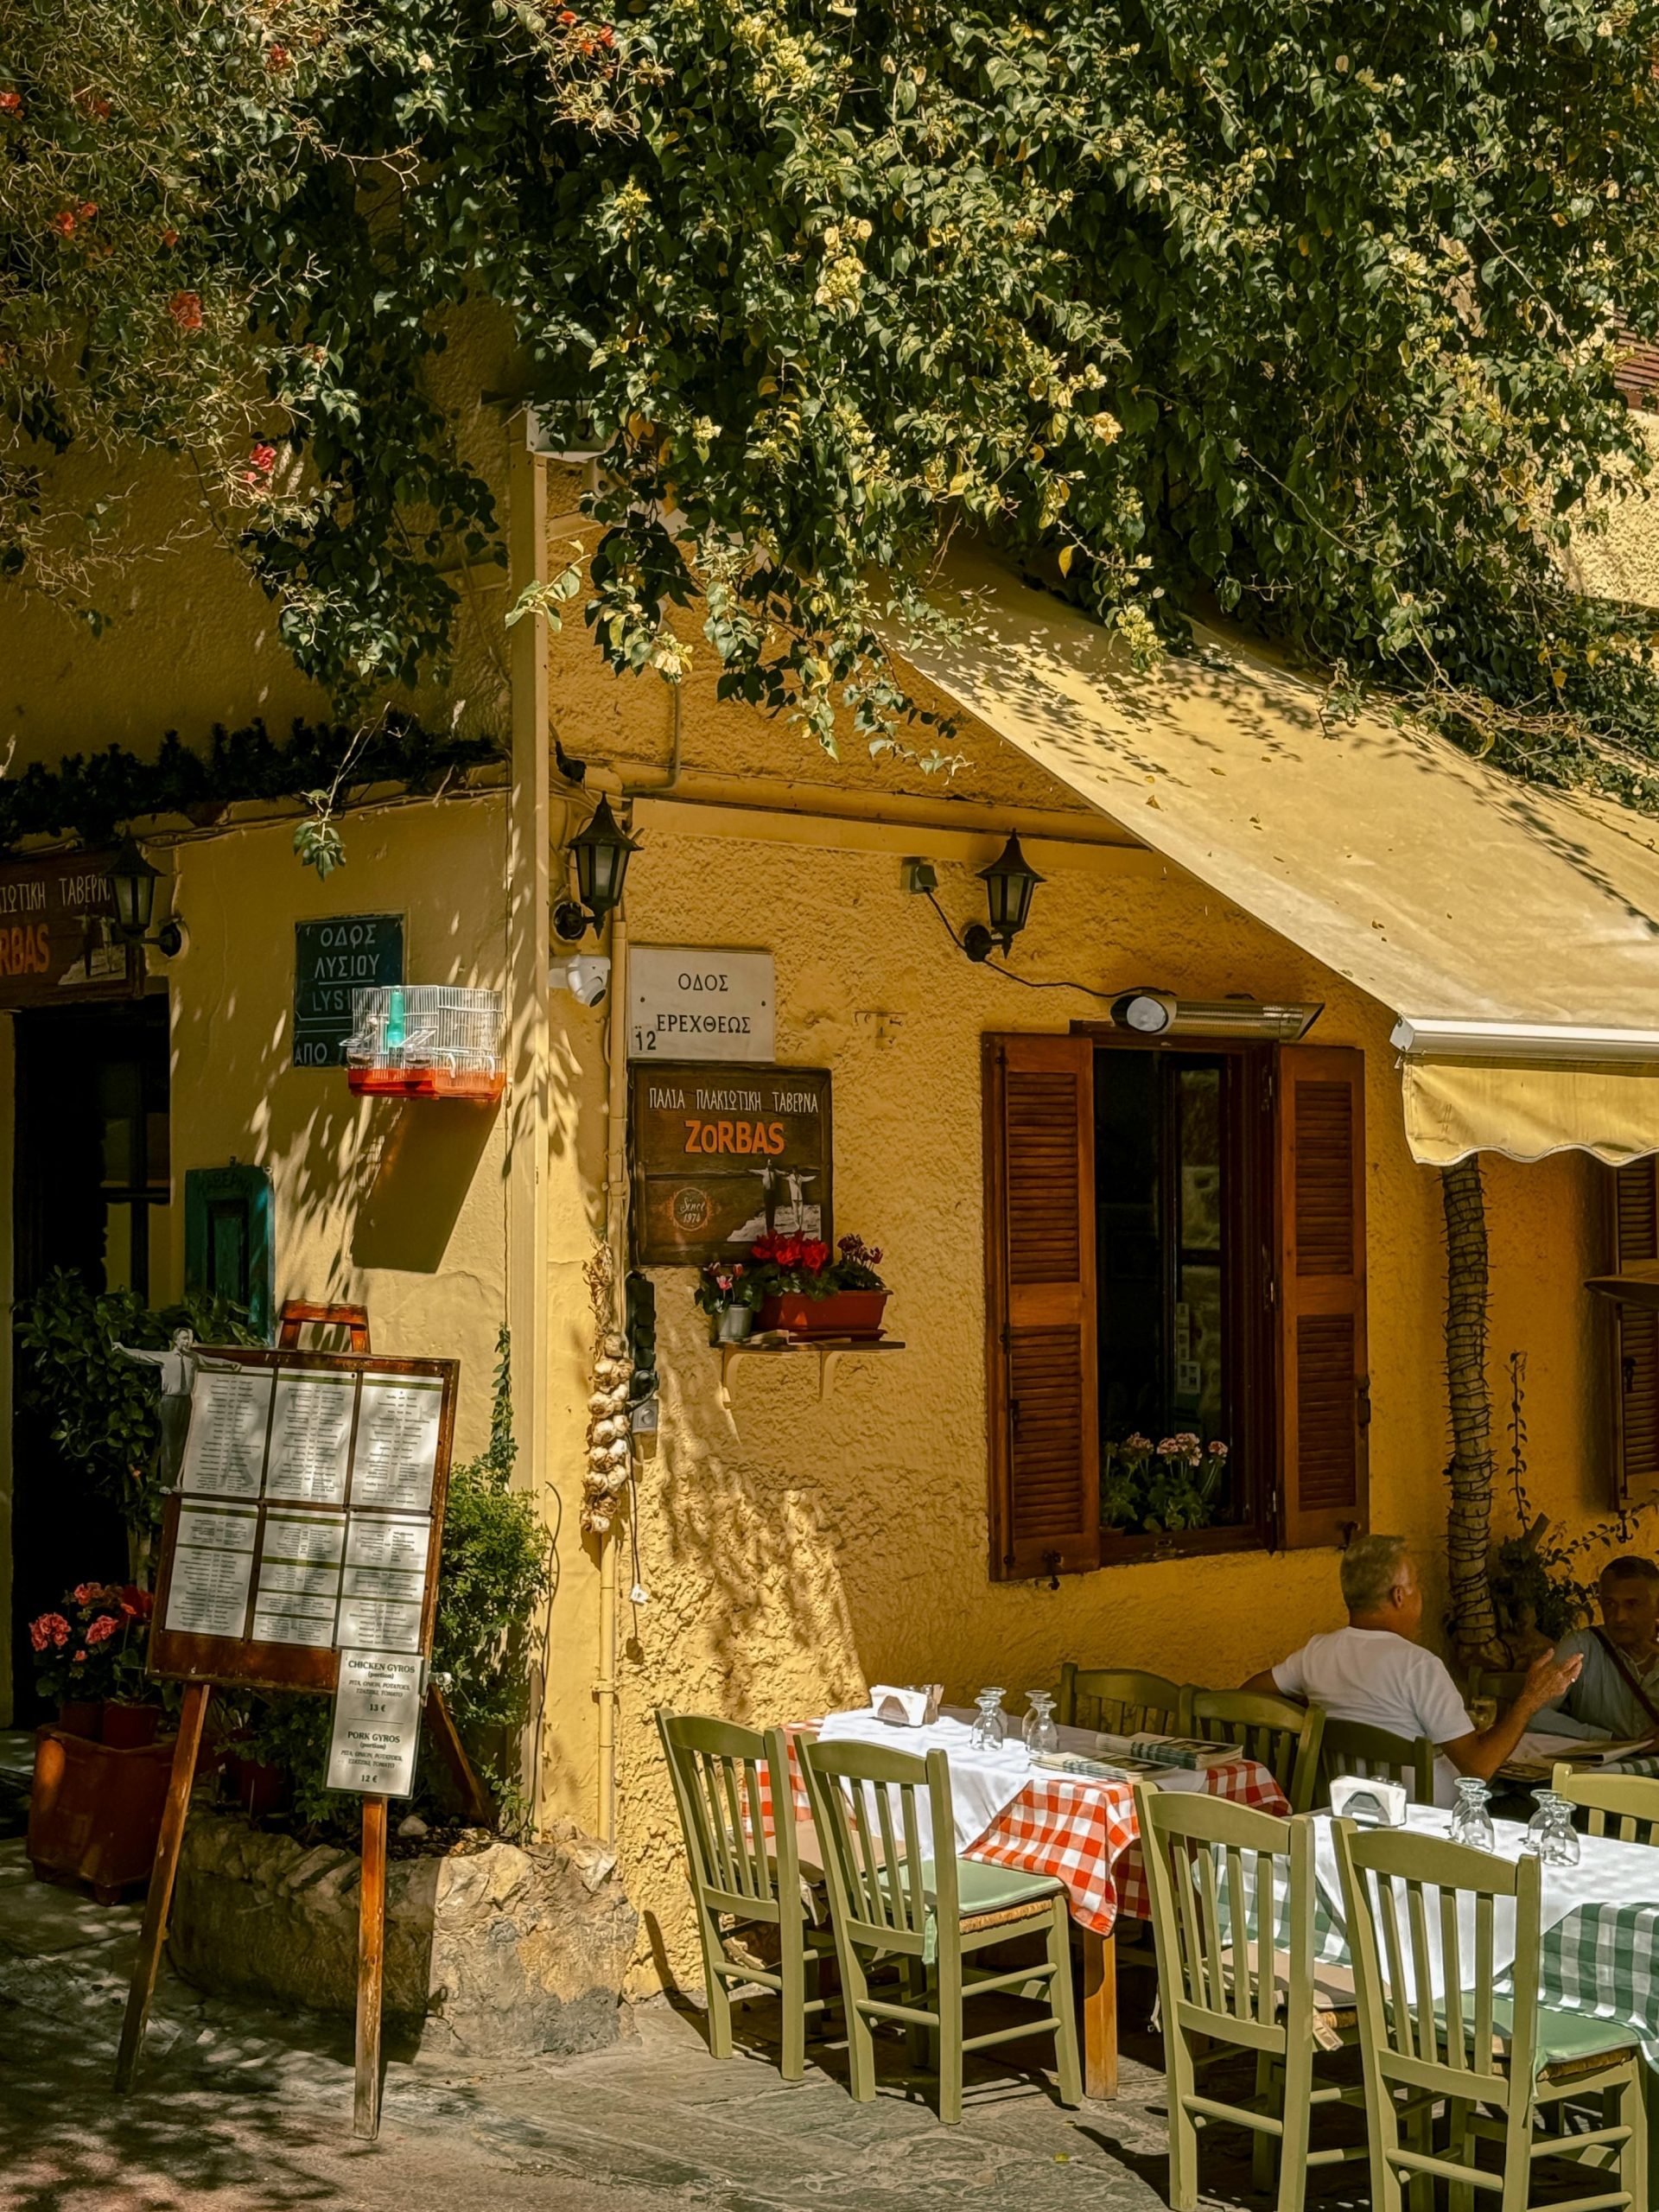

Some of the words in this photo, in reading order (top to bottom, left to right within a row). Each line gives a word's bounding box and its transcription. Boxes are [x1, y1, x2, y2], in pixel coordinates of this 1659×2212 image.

[0, 881, 46, 913] ΙΩΤΙΚΗ
[59, 874, 111, 906] ΤΑΒΕΡΝ
[321, 924, 377, 948] ΟΔΟΣ
[314, 954, 380, 979] ΛΥΣΙΟΥ
[678, 973, 728, 992] ΟΔΟΣ
[313, 988, 357, 1012] LYSI
[657, 1014, 751, 1034] ΕΡΕΧΘΕΩΣ
[635, 1030, 657, 1051] 12
[649, 1087, 685, 1109] ΠΑΛΙΑ
[696, 1089, 762, 1112] ΠΛΑΚΙΩΤΙΚΗ
[772, 1091, 819, 1113] ΤΑΒΕΡΝΑ
[684, 1120, 785, 1155] ZORBAS
[678, 1196, 706, 1214] Since
[348, 1660, 385, 1670] CHICKEN
[387, 1663, 415, 1673] GYROS
[370, 1703, 378, 1712] 13
[381, 1704, 386, 1713] €
[347, 1731, 370, 1740] PORK
[372, 1733, 400, 1743] GYROS
[361, 1774, 370, 1783] 12
[372, 1775, 378, 1783] €
